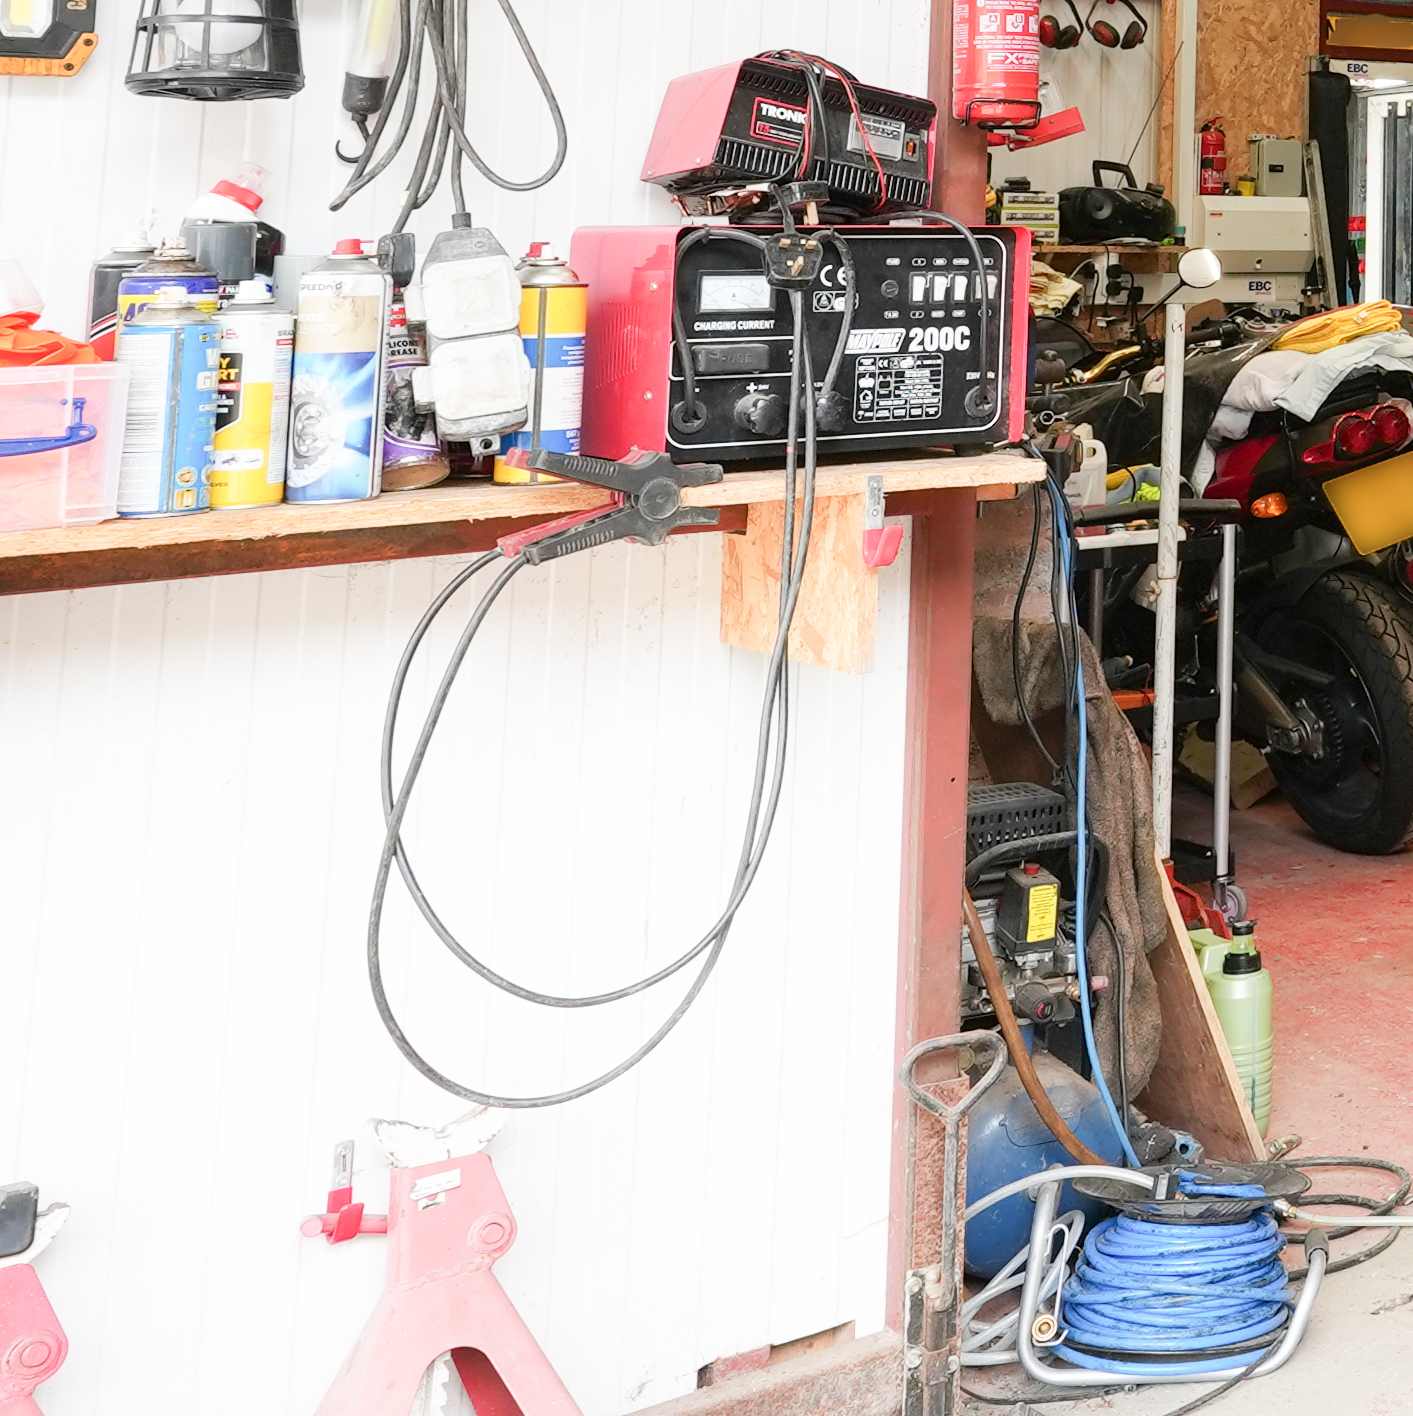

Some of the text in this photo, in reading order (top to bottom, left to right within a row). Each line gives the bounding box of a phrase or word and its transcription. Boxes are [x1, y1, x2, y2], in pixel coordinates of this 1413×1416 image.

[1347, 63, 1369, 74] EBC
[1249, 281, 1272, 292] EBC
[693, 319, 775, 332] CHARGING CURRENT
[908, 325, 970, 352] 200C
[388, 340, 419, 349] LICONE
[388, 348, 418, 357] REASE
